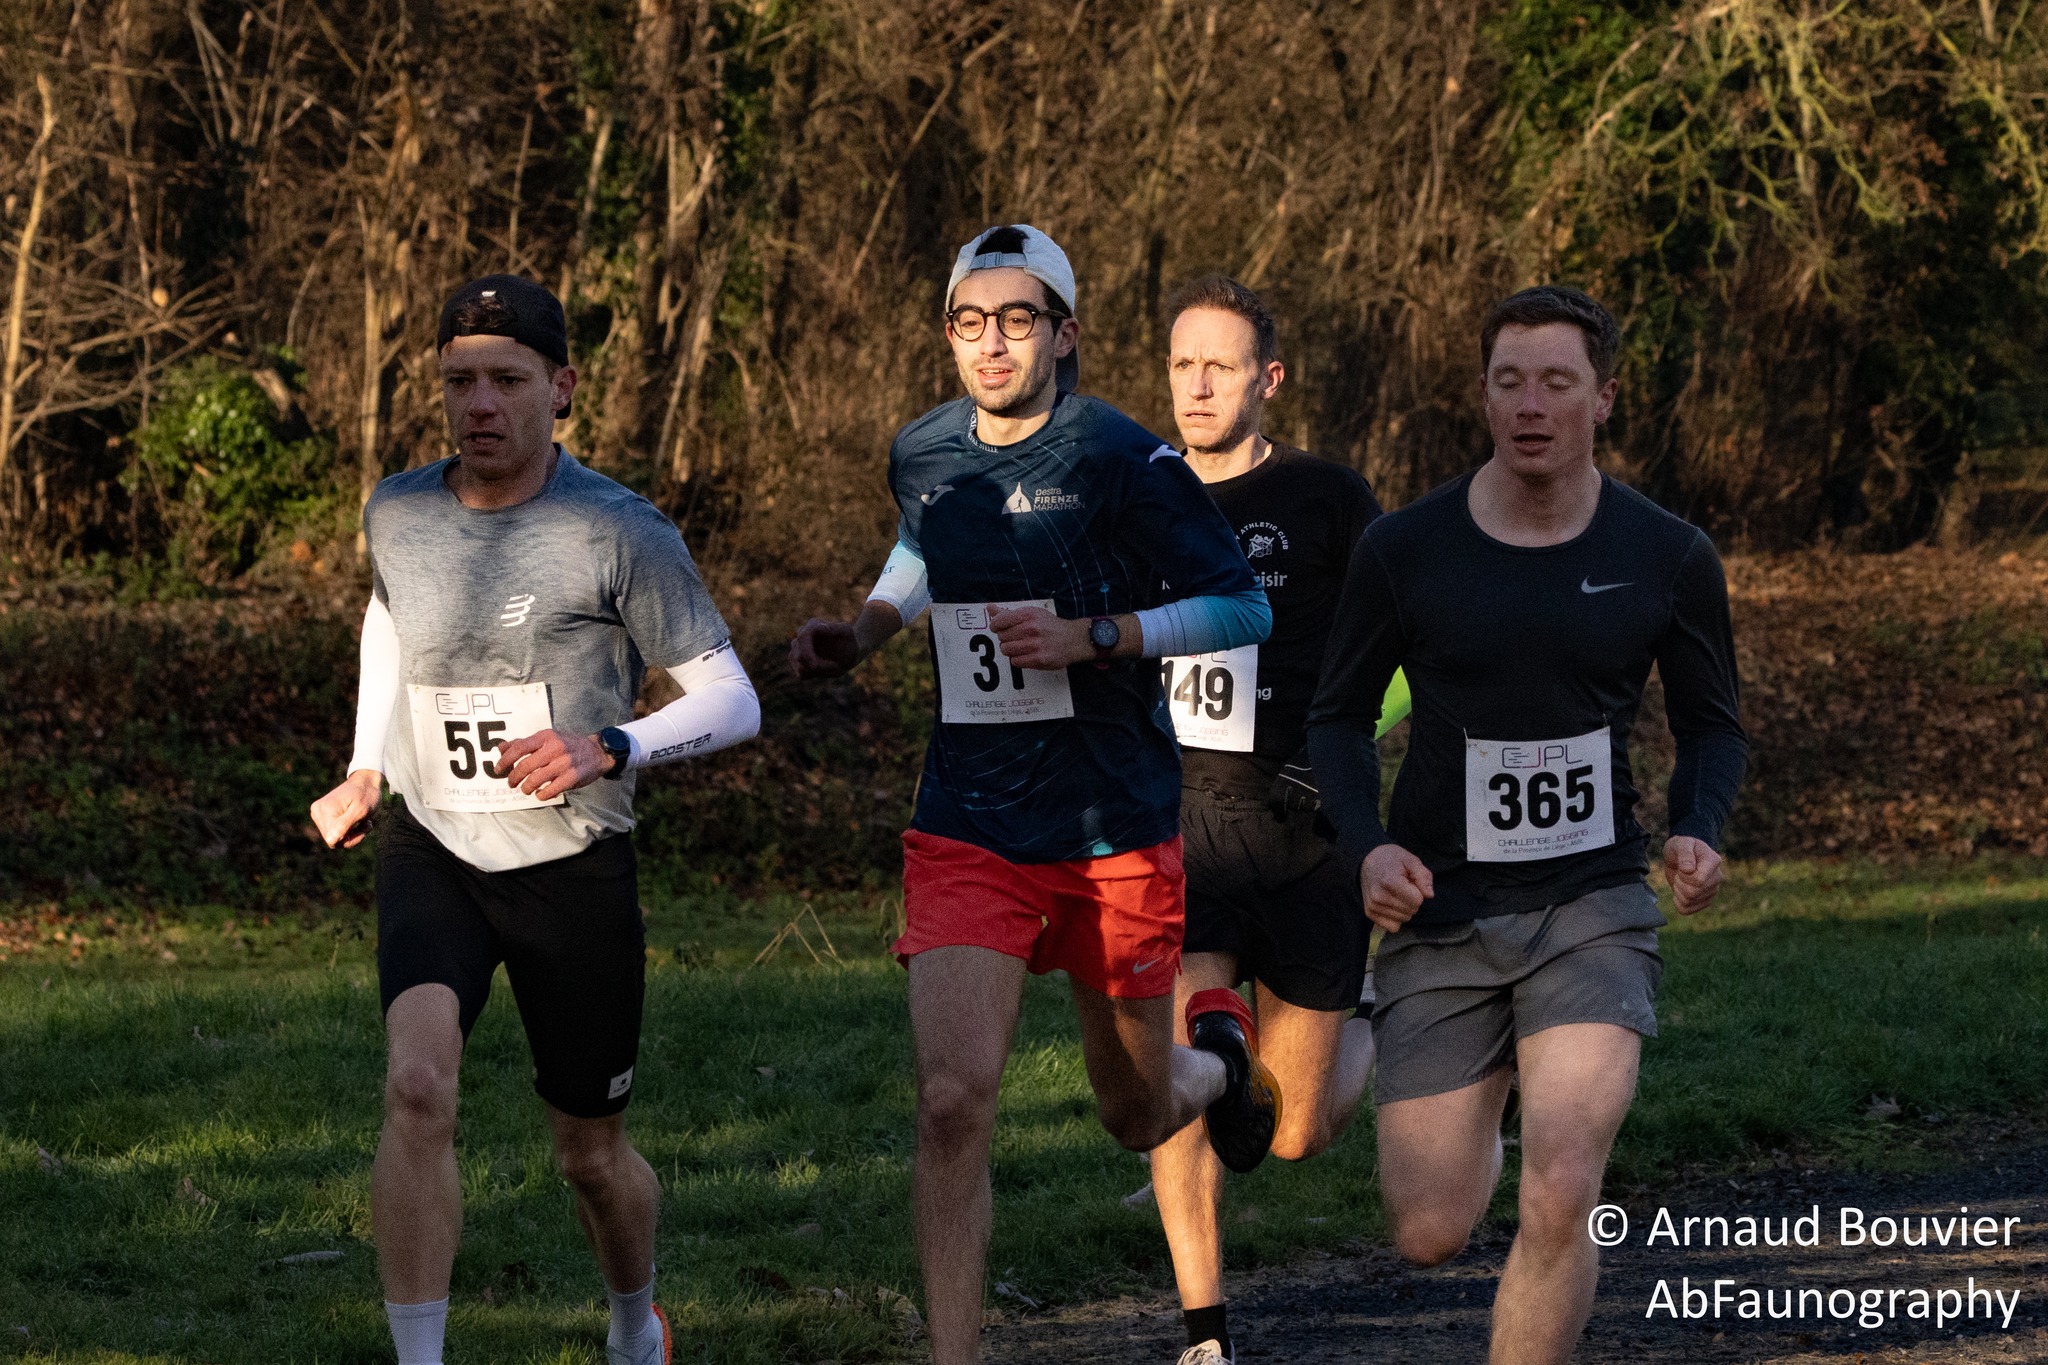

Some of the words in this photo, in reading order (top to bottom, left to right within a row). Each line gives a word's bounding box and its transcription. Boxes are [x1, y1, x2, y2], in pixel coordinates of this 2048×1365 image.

[1033, 502, 1086, 512] MARATHON
[1034, 494, 1079, 504] FIRENZE
[1240, 521, 1278, 535] ATHLETIC
[1277, 531, 1289, 551] CLUB
[1257, 571, 1288, 587] isir
[1161, 659, 1234, 721] 149
[444, 720, 515, 780] 55
[649, 733, 712, 760] BOOSTER
[1488, 764, 1595, 831] 365
[1498, 837, 1551, 847] CHALLENGE
[1552, 829, 1589, 843] JOGGING
